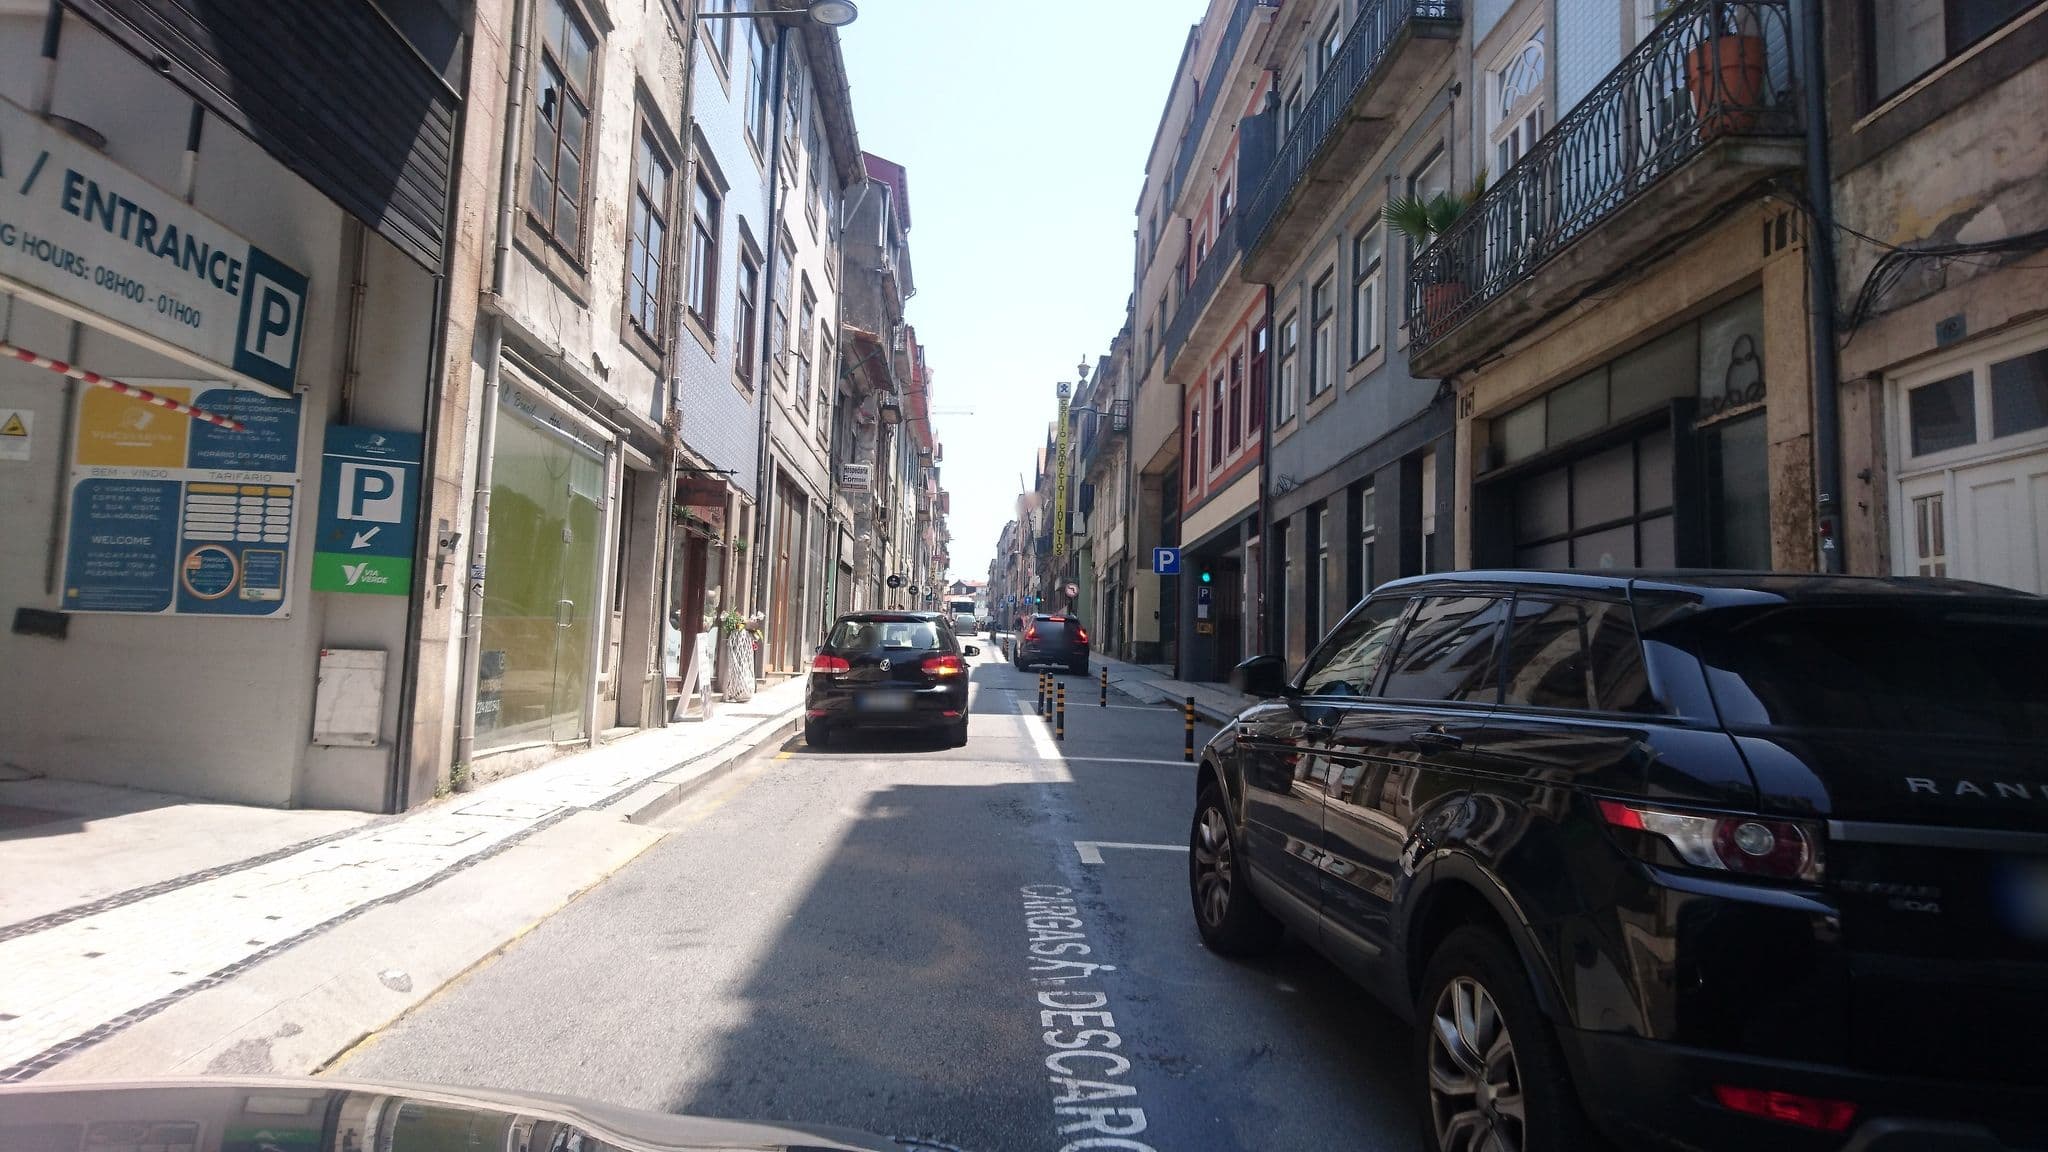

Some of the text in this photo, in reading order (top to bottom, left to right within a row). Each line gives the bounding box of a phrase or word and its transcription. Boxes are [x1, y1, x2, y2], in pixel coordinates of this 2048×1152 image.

[61, 167, 242, 296] ENTRANCE
[22, 232, 90, 280] HOURS:
[95, 265, 145, 304] 08H00
[158, 294, 201, 329] 01H00
[255, 287, 291, 354] P
[92, 468, 117, 476] BEM
[133, 470, 168, 478] VINDO
[351, 468, 394, 517] P
[91, 535, 152, 545] WELCOME
[364, 569, 378, 577] VIA
[1159, 551, 1174, 571] P
[361, 576, 389, 584] VERDE
[1904, 776, 2048, 800] RAN
[1020, 884, 1091, 956] CARGAS
